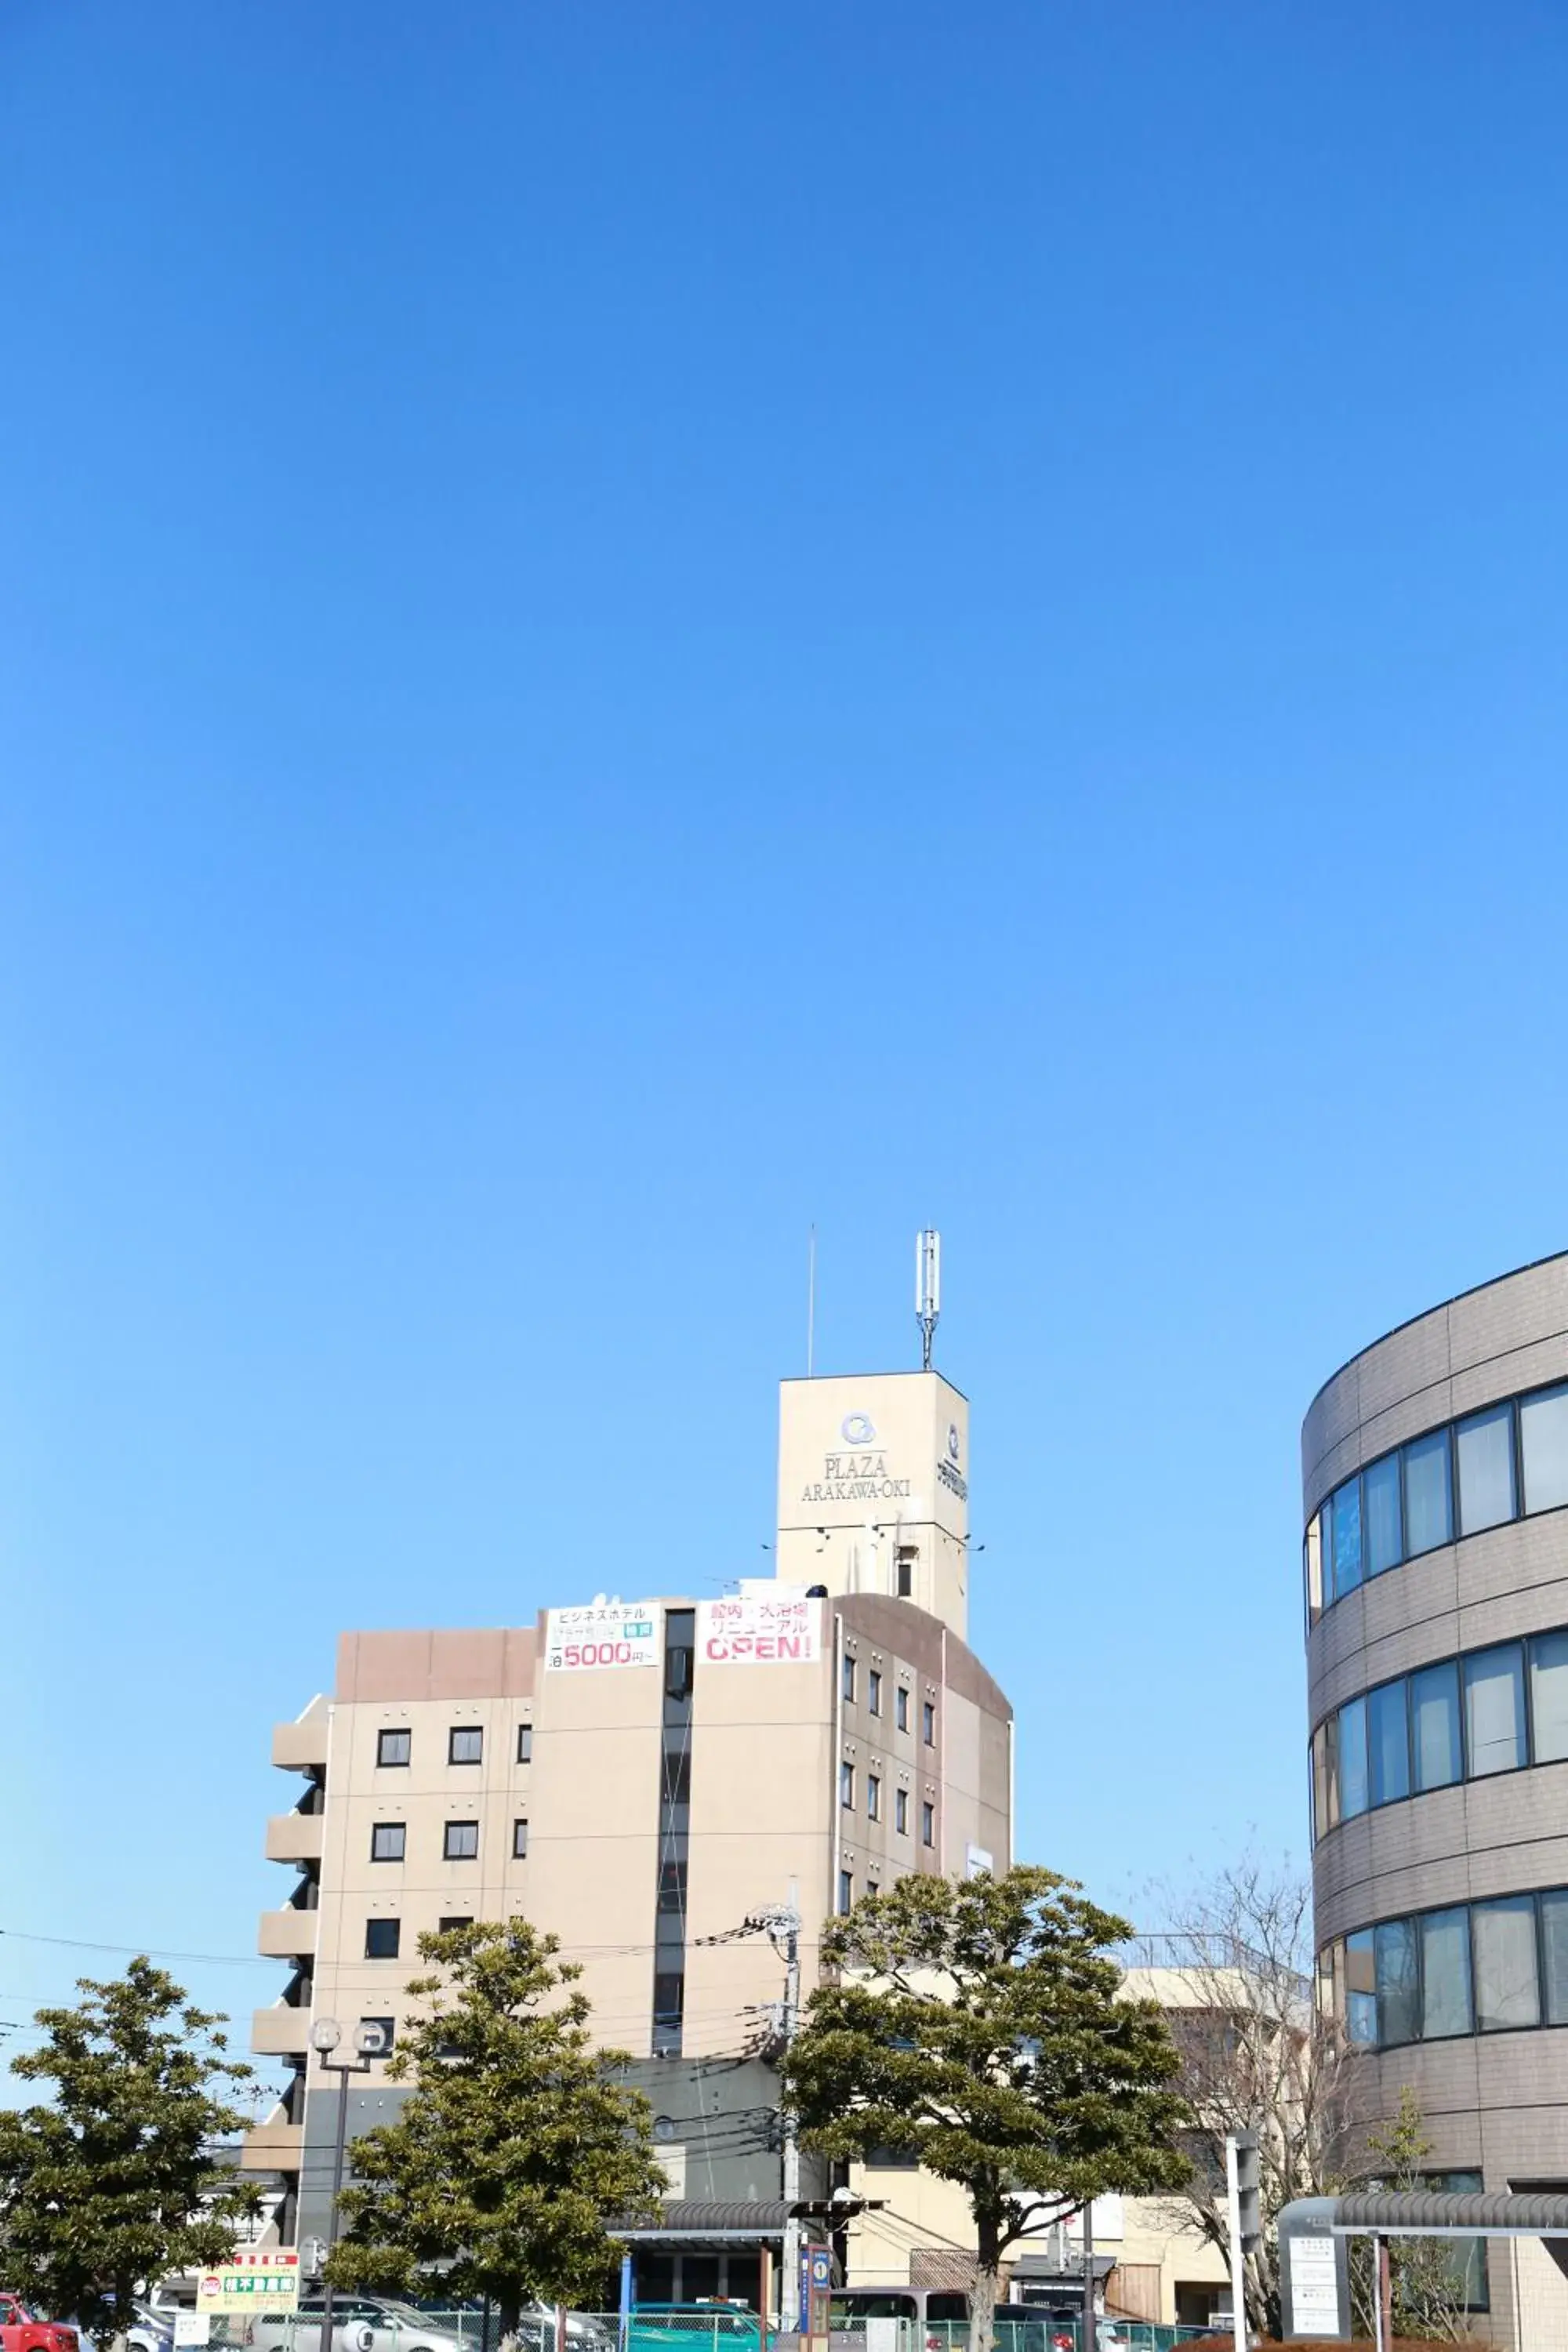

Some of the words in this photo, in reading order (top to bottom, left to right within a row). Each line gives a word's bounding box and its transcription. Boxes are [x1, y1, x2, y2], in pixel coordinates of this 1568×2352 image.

[825, 1455, 887, 1479] PLAZA
[801, 1479, 910, 1501] ARAKAWA-OKI
[559, 1608, 646, 1624] ビジネスホテル
[712, 1620, 808, 1635] リニューアル
[706, 1636, 811, 1661] OPEN!
